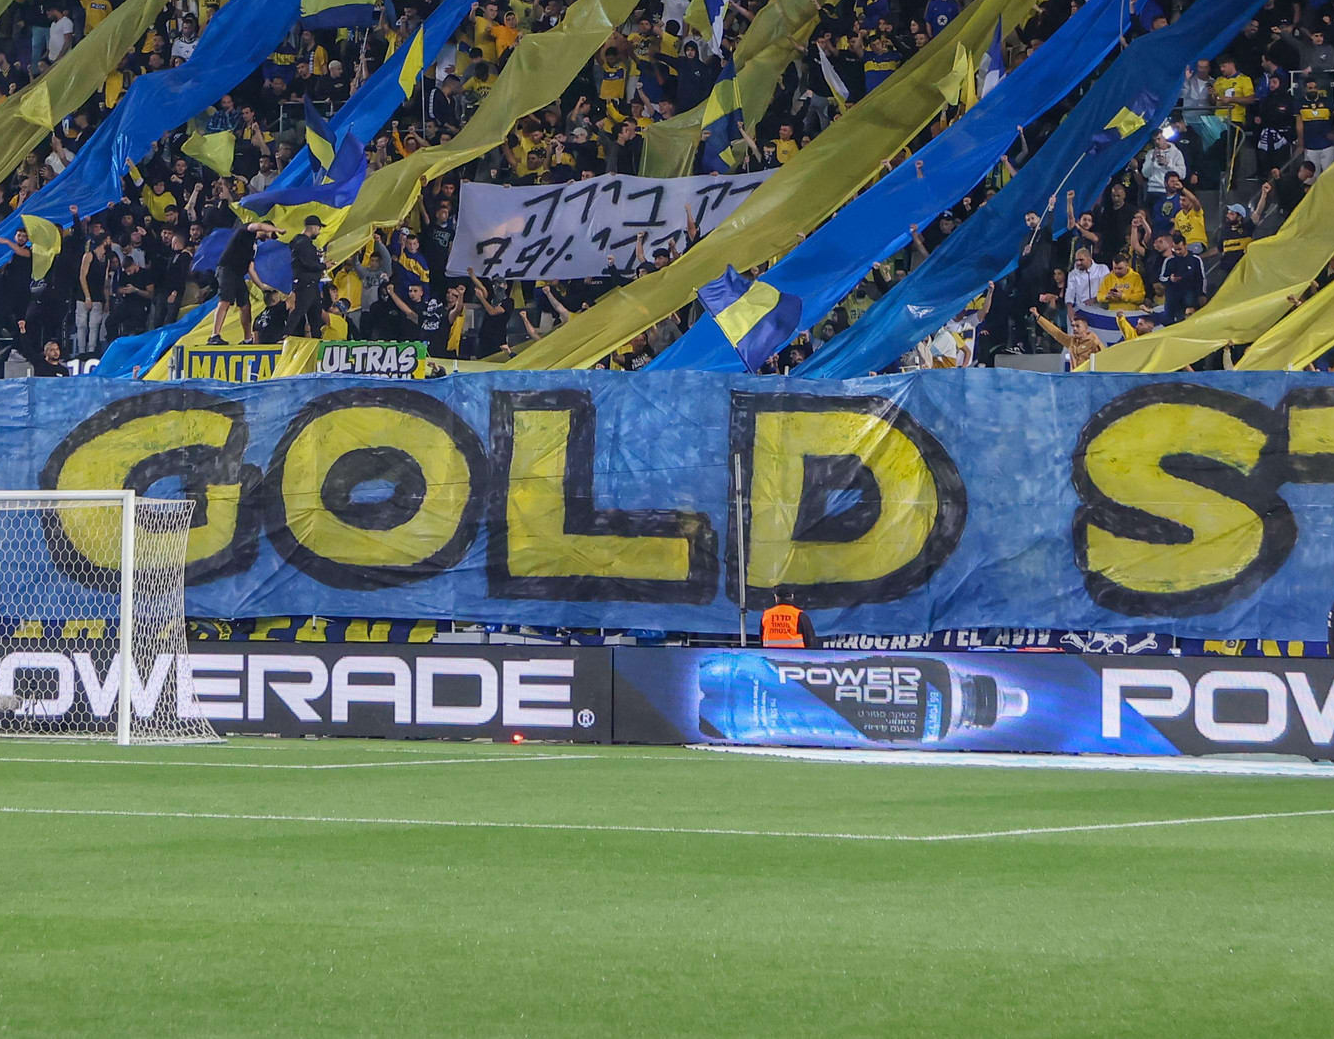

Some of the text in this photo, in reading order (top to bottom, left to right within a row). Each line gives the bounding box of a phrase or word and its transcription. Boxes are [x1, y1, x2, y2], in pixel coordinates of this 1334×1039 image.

[192, 354, 281, 383] MACCA
[322, 345, 416, 373] ULTRAS
[41, 388, 967, 606] GOLD
[778, 666, 922, 686] POWER
[834, 685, 919, 704] ADE
